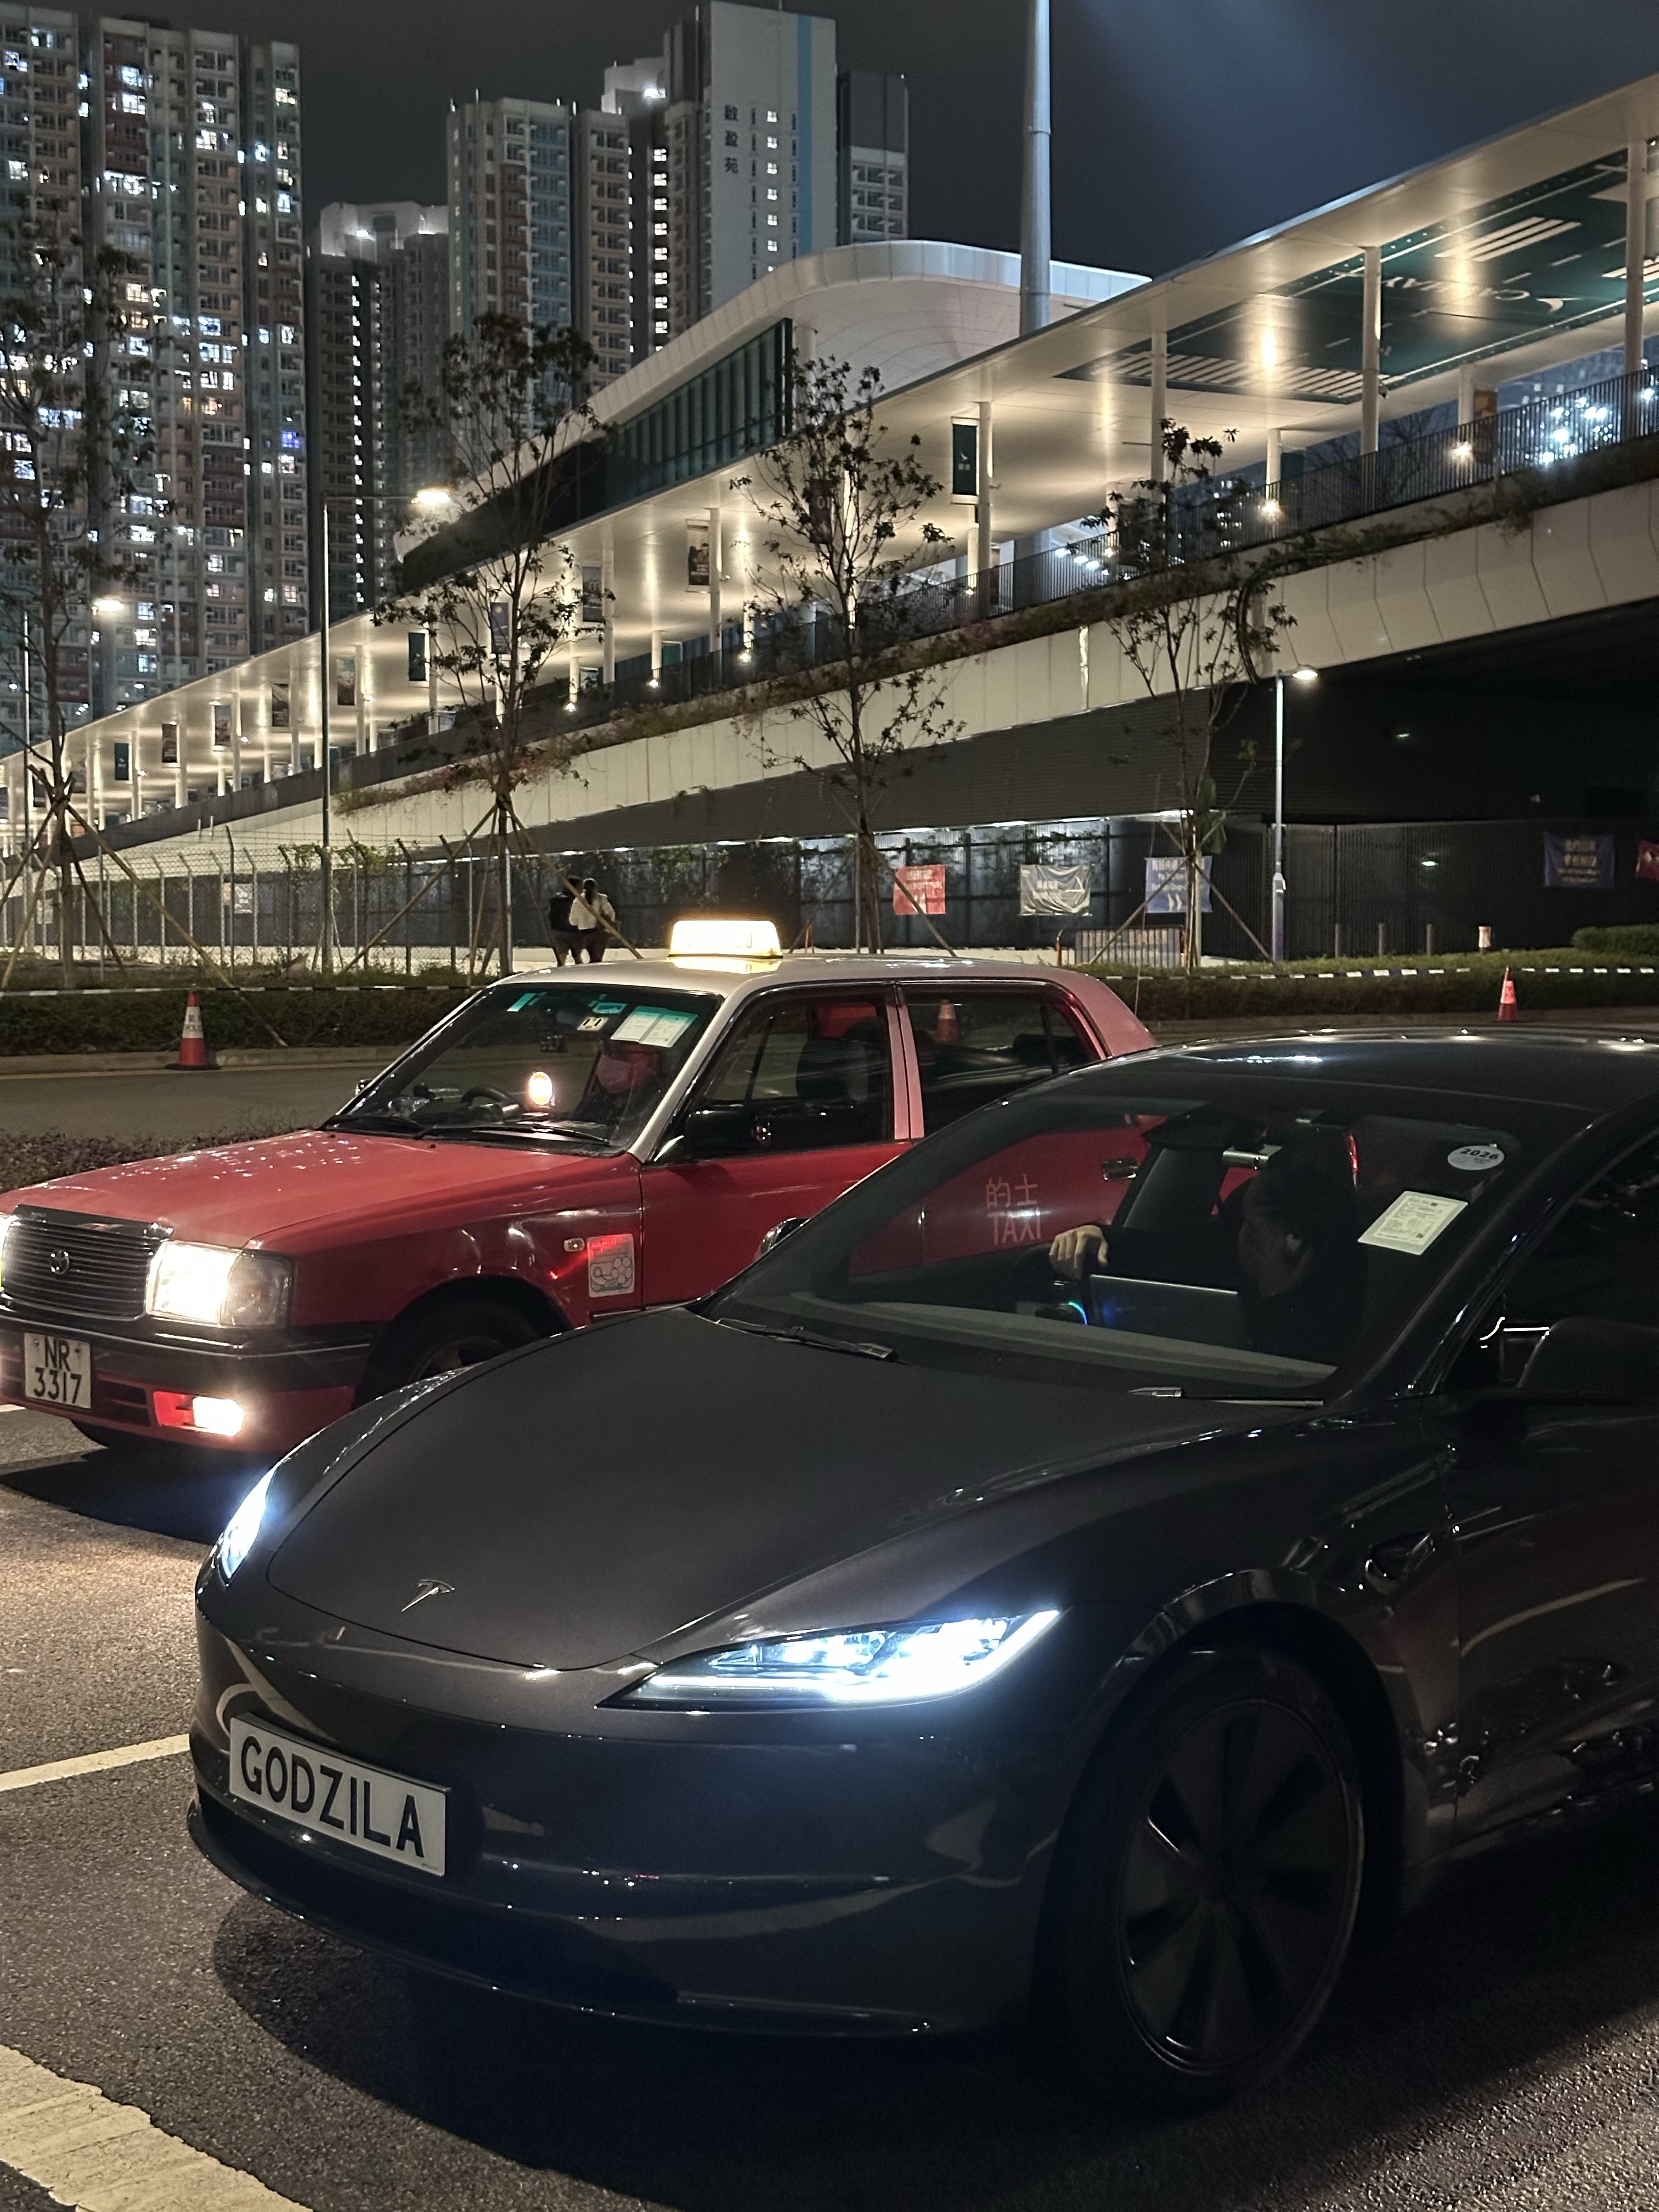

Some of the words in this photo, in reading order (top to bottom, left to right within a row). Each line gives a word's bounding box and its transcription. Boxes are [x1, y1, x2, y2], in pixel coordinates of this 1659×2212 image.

[1460, 1148, 1500, 1160] 2026
[986, 1173, 1039, 1209] 的士
[987, 1207, 1041, 1245] TAXI
[44, 1335, 71, 1372] NR
[33, 1367, 82, 1404] 3317
[241, 1736, 424, 1858] GODZILA
